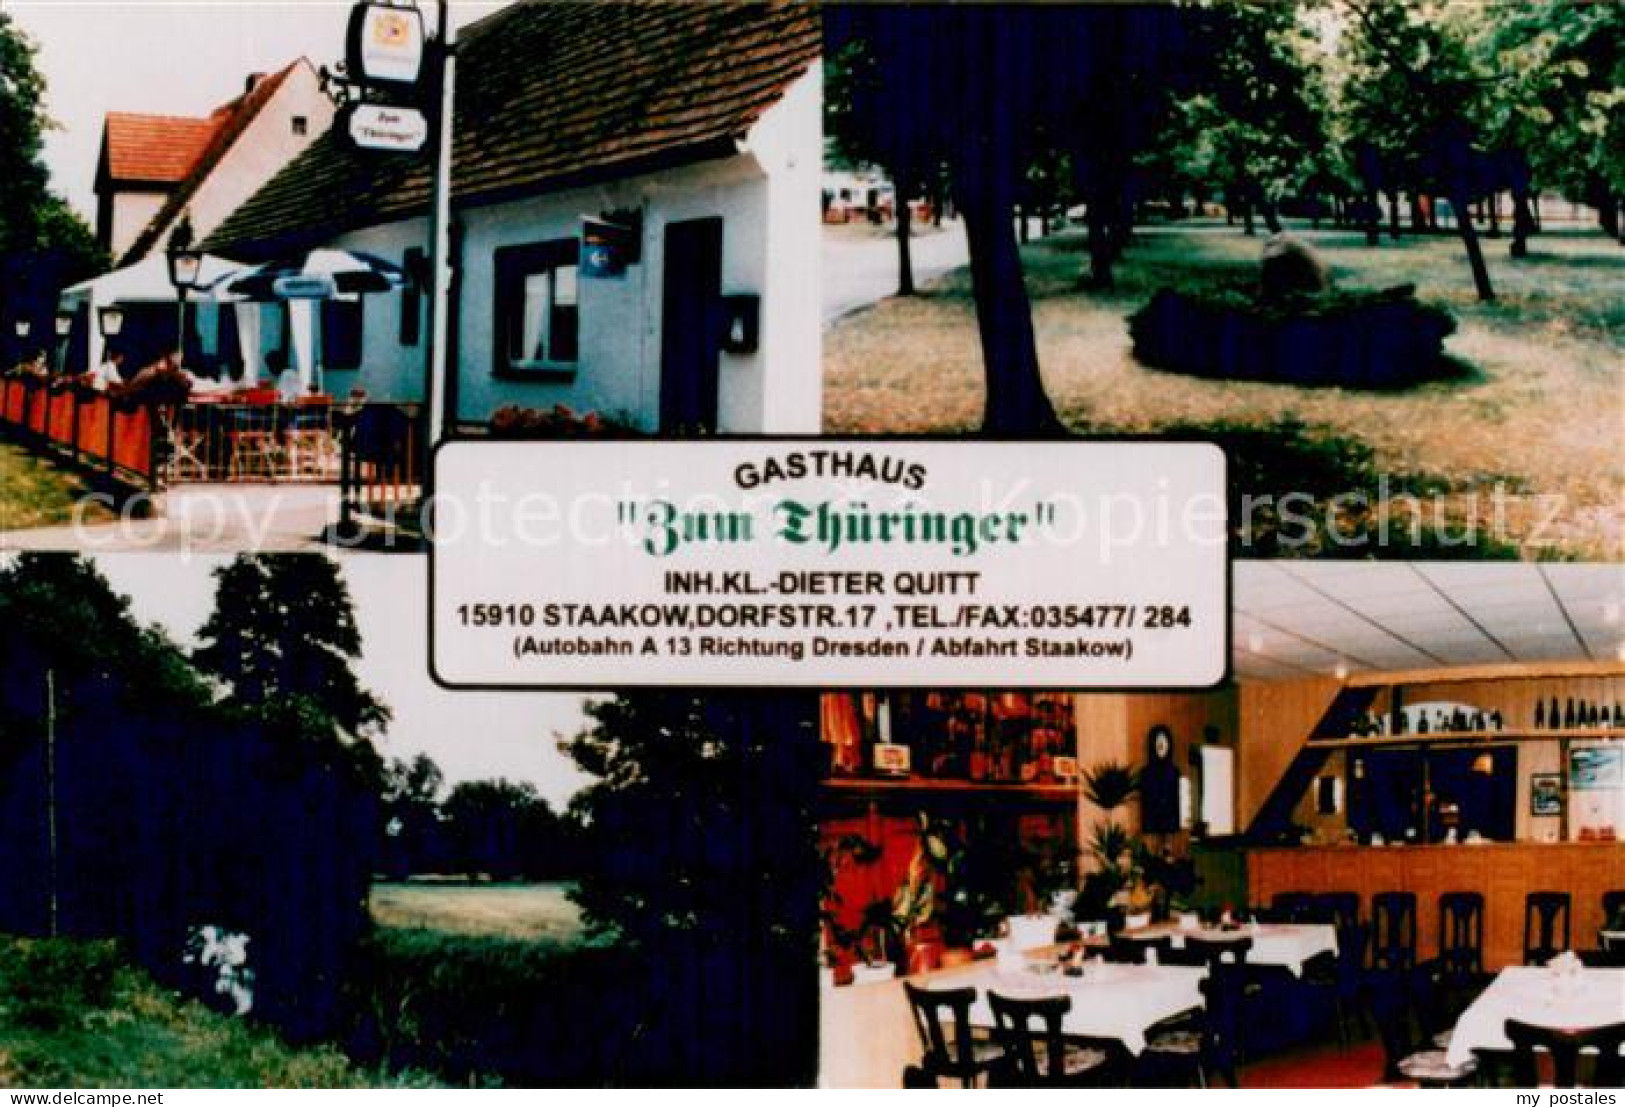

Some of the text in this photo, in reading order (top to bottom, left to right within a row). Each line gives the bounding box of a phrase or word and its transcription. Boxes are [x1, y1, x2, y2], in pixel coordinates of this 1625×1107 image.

[733, 449, 927, 491] GASTHAUS
[664, 571, 981, 597] INH.KL.-DIETER QUITT
[457, 603, 535, 628] 15910
[1143, 605, 1192, 628] 284
[513, 635, 1134, 662] (Autobahn A 13 Richtung Dresden / Abfahrt Staakow)
